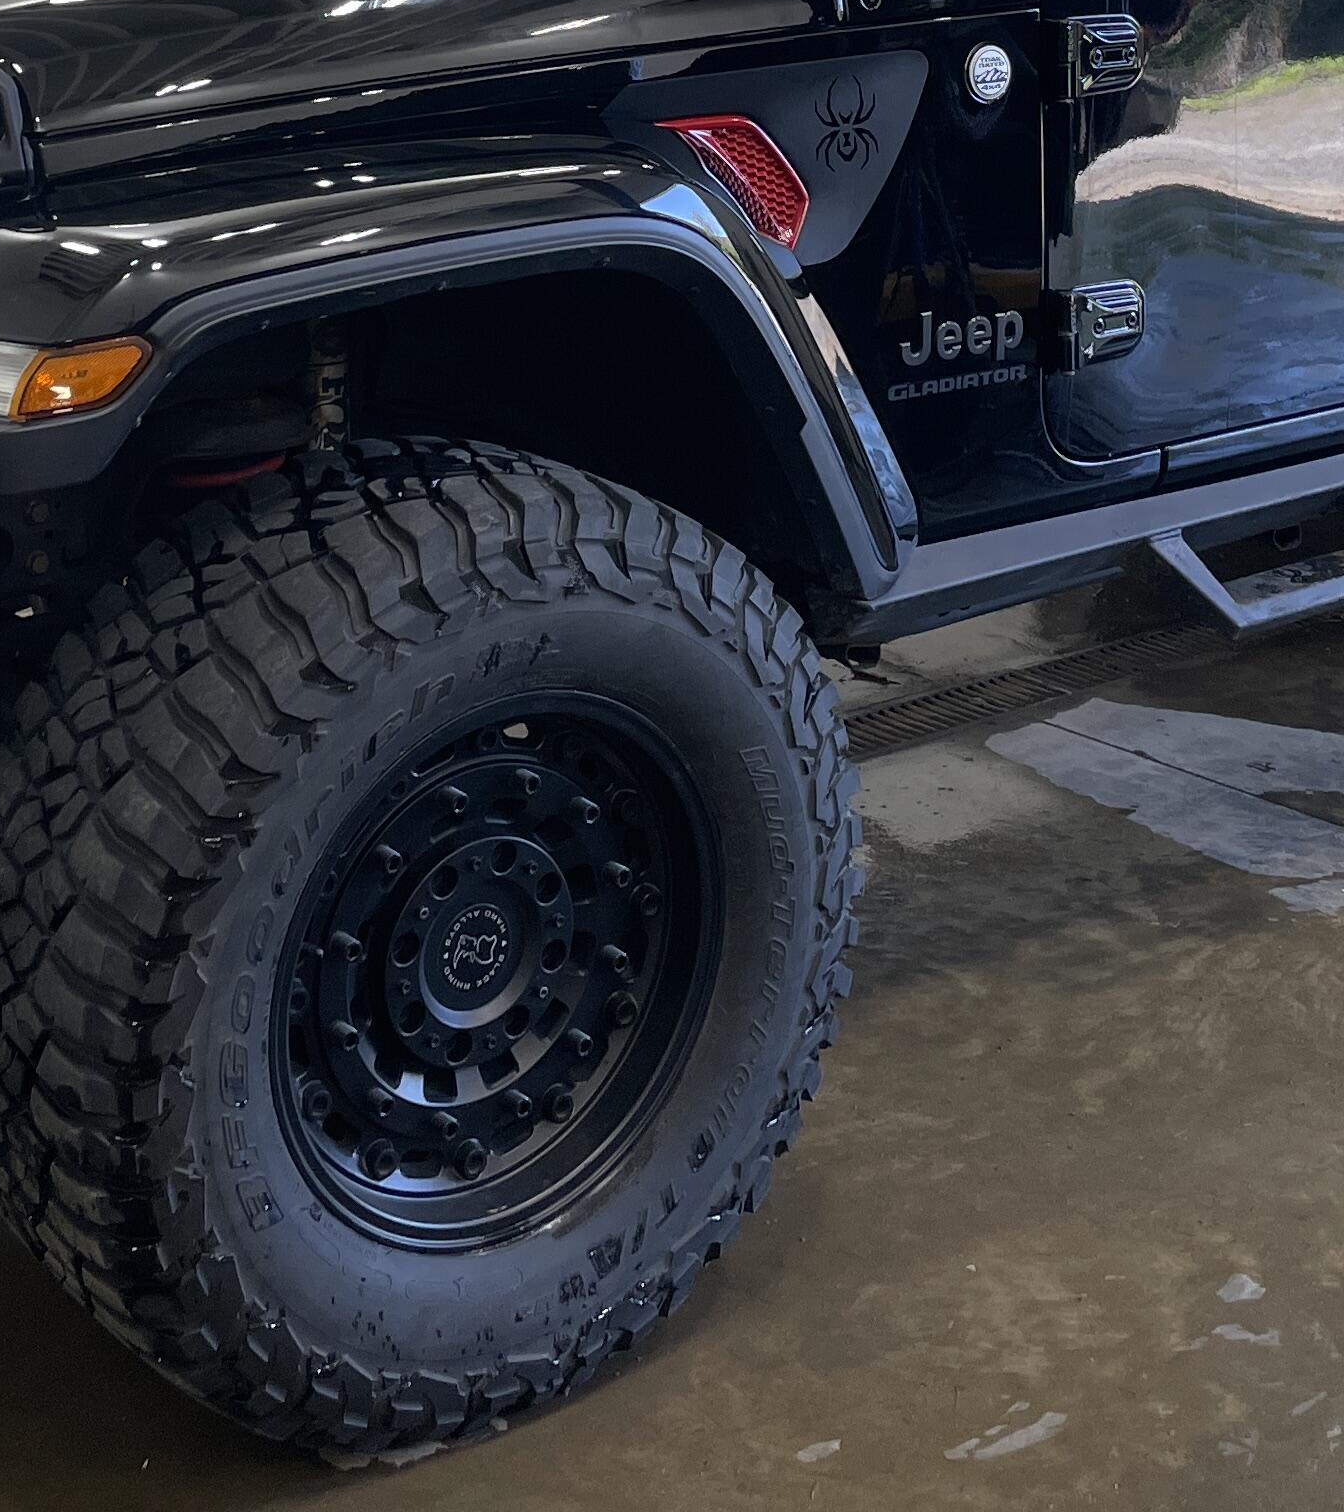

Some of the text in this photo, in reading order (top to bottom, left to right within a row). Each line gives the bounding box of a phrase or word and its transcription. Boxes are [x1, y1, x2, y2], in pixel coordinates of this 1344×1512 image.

[899, 310, 1024, 367] Jeep
[887, 364, 1028, 402] GLADIATOR
[444, 909, 508, 947] HARD ALLOYS
[442, 953, 506, 991] BLACK RHINO
